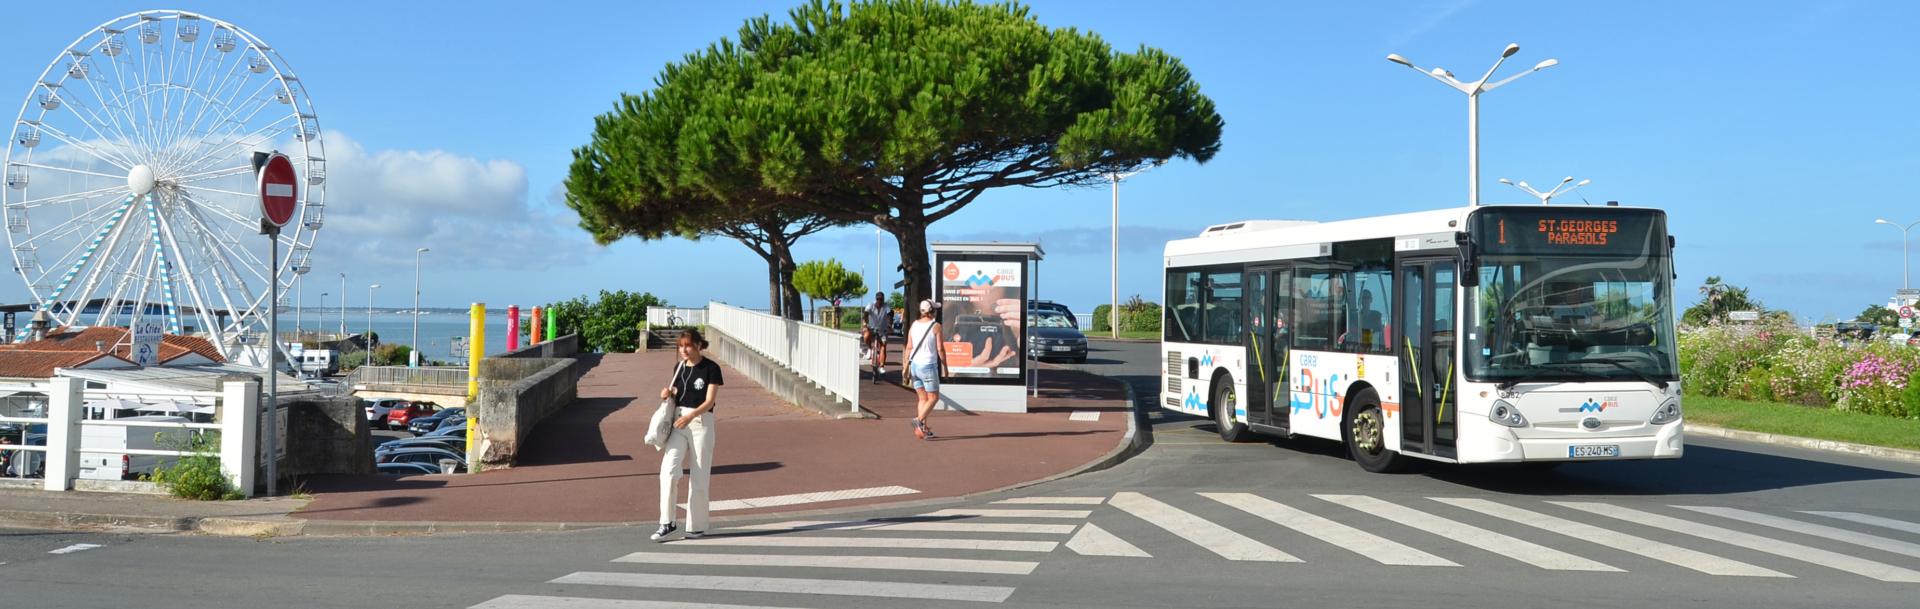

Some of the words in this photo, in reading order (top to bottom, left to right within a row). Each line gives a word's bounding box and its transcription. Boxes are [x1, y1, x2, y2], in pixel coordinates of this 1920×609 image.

[1498, 219, 1506, 244] 1
[1538, 220, 1617, 232] ST.GEORGES
[1548, 232, 1607, 245] PARASOLS
